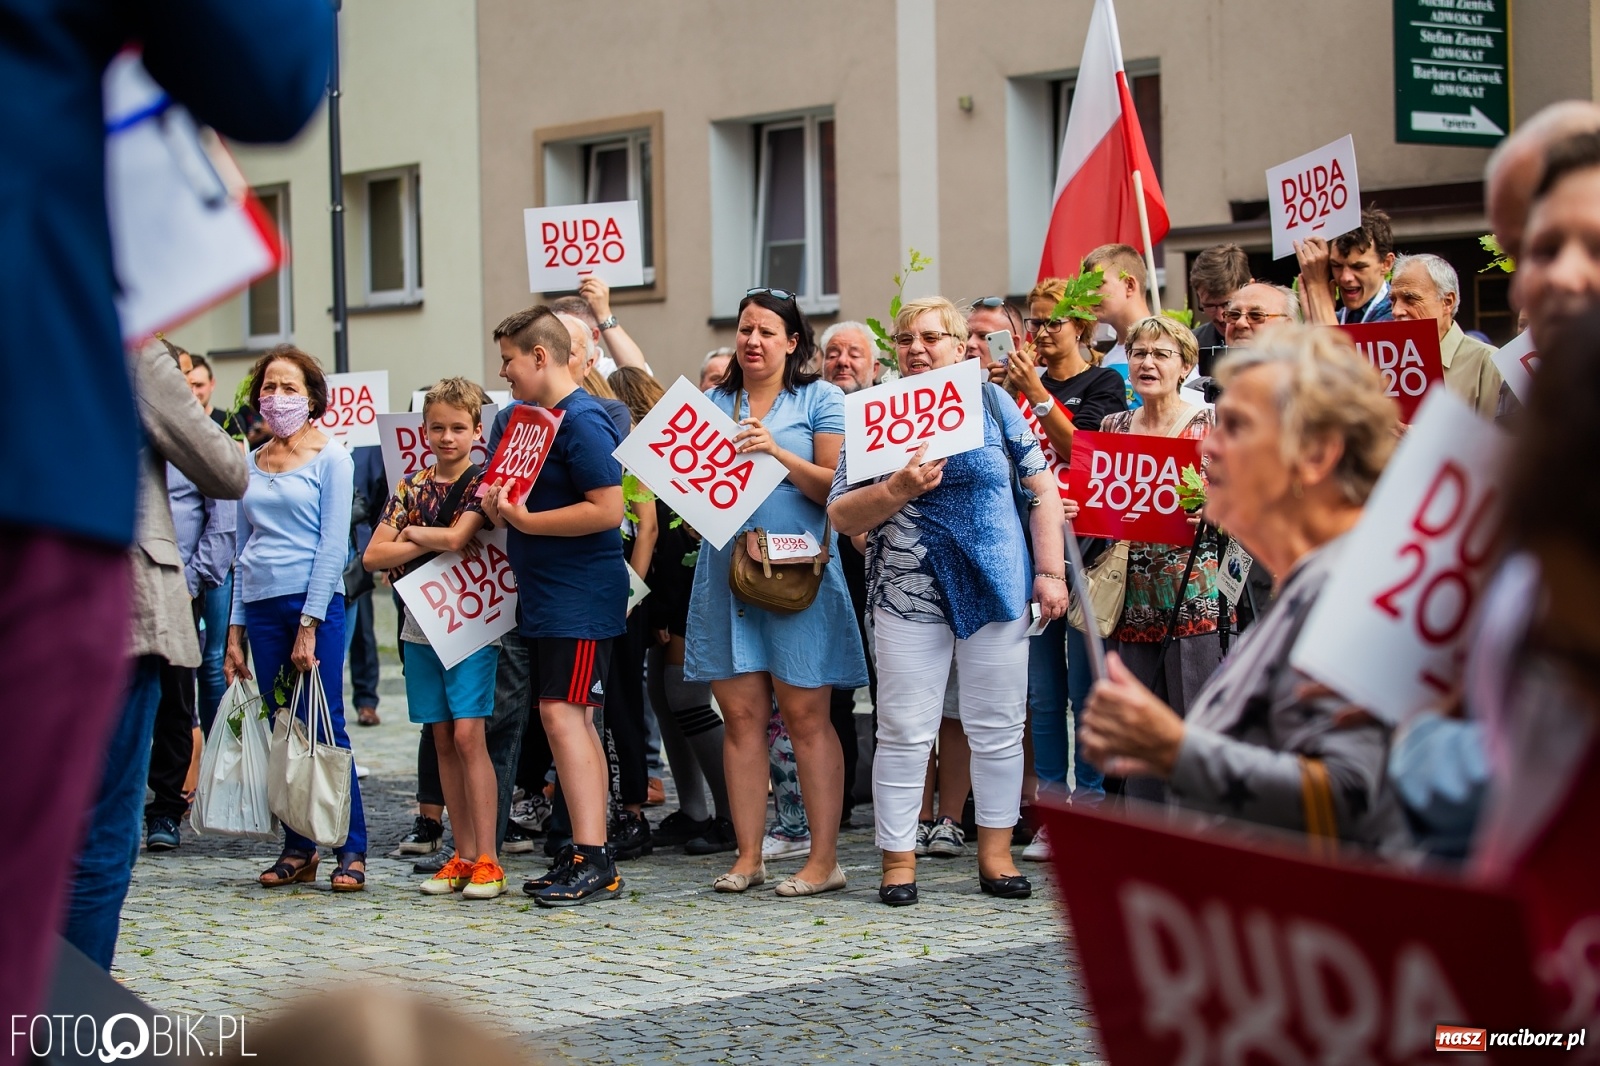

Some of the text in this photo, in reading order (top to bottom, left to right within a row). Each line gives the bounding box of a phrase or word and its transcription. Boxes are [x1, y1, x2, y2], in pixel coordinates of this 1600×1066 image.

[1430, 10, 1484, 26] ADWOKAT
[1420, 28, 1494, 48] Stefan Zientek
[1430, 46, 1484, 61] ADWOKAT
[1413, 64, 1456, 81] Barbara
[1431, 82, 1485, 98] ADWOKAT
[1281, 158, 1345, 205] DUDA
[1285, 183, 1348, 230] 2020
[541, 217, 622, 245] DUDA
[544, 240, 625, 268] 2020
[1355, 338, 1425, 370] UDA
[326, 385, 374, 408] UDA
[1380, 366, 1428, 397] 20
[864, 380, 963, 428] DUDA
[508, 422, 549, 453] DUDA
[866, 405, 966, 453] 2020
[401, 445, 488, 475] 200
[495, 447, 539, 479] 2020
[667, 402, 756, 492] DUDA
[648, 427, 739, 511] 2020
[1090, 450, 1181, 486] DUDA
[1085, 478, 1181, 515] 2020
[1411, 456, 1499, 568] DU
[771, 537, 806, 545] DUDA
[775, 543, 809, 551] 2020
[420, 543, 509, 611] DUDA
[438, 565, 518, 635] 2020
[1371, 542, 1472, 647] 20
[1119, 878, 1482, 1056] DUDA
